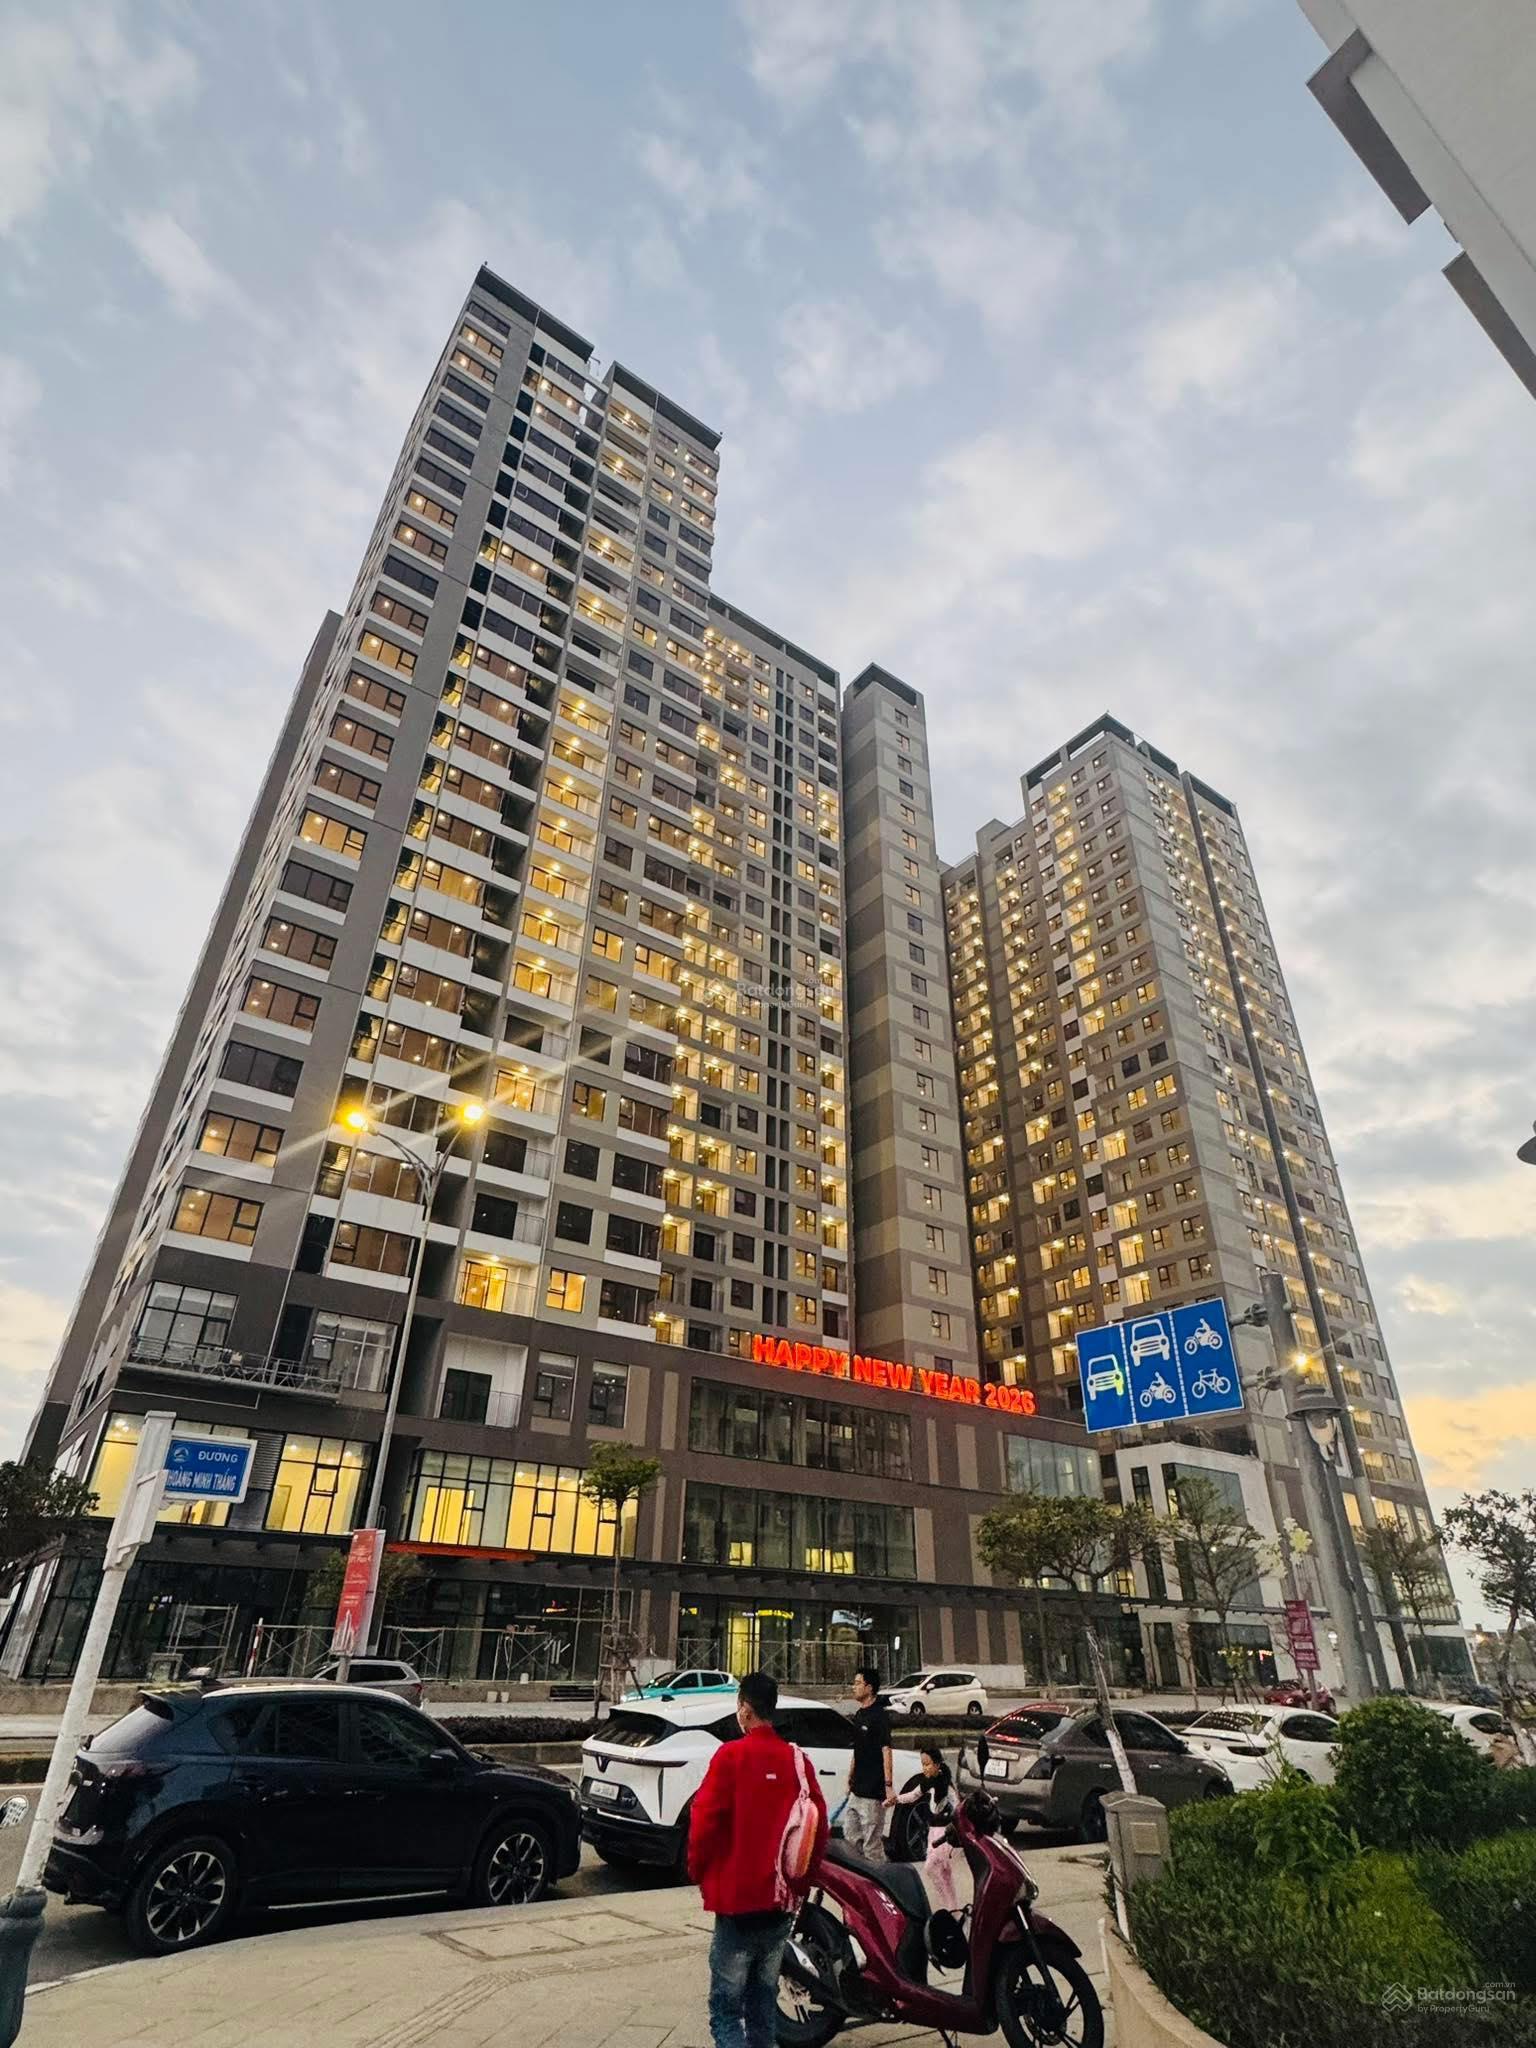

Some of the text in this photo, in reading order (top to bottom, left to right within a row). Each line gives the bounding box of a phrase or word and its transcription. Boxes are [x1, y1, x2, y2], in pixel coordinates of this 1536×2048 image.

[753, 1334, 1036, 1414] HAPPY NEW YEAR 2026
